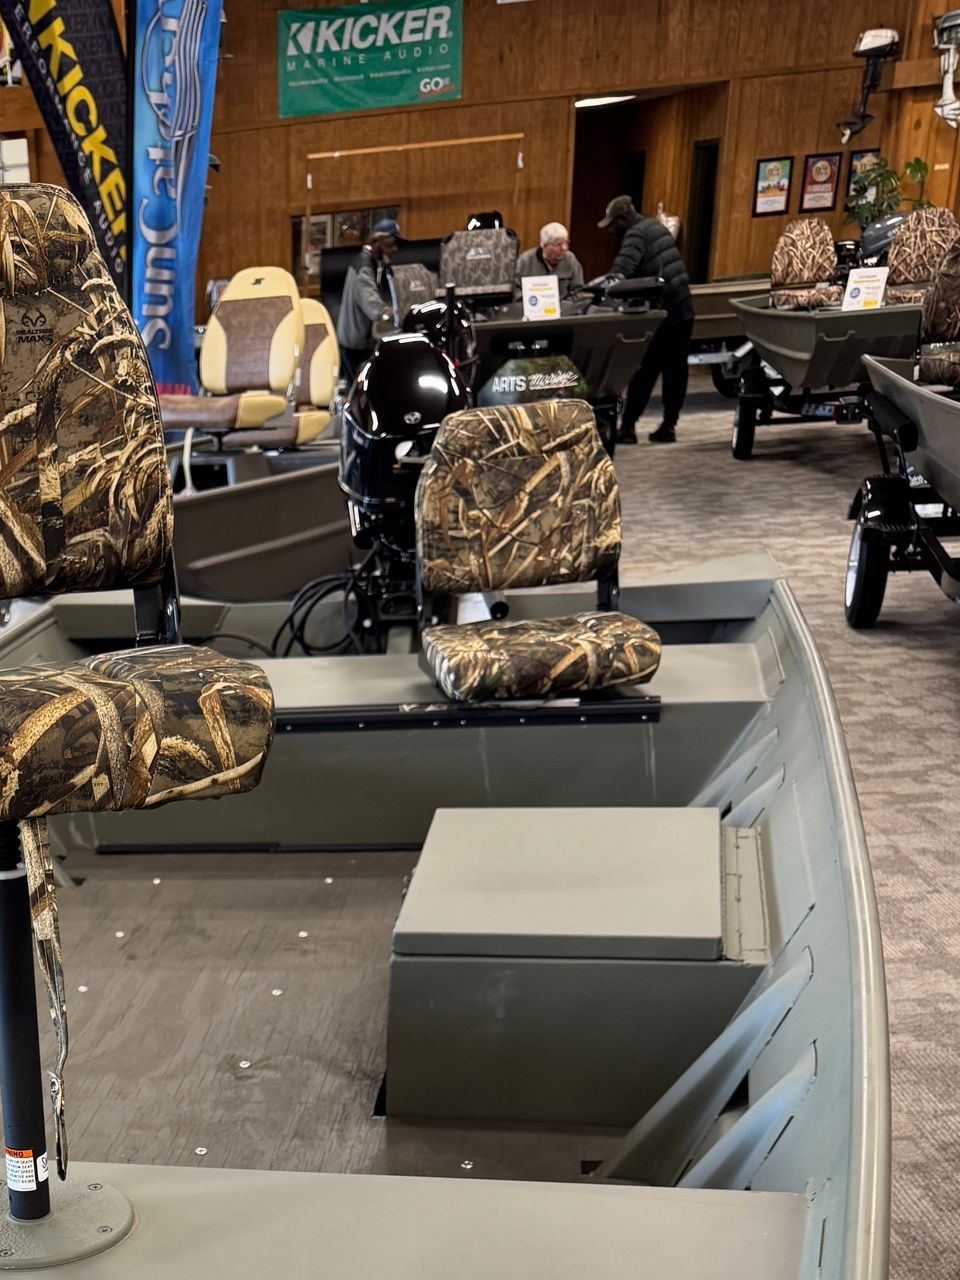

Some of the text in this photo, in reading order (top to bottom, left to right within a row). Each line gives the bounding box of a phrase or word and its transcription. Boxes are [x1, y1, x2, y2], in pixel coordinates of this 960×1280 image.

[315, 5, 452, 54] KICKER
[287, 43, 448, 71] MARINE AUDIO
[14, 3, 92, 185] ERFORMANCE
[91, 200, 124, 274] AUDIO
[492, 375, 527, 393] ARTS
